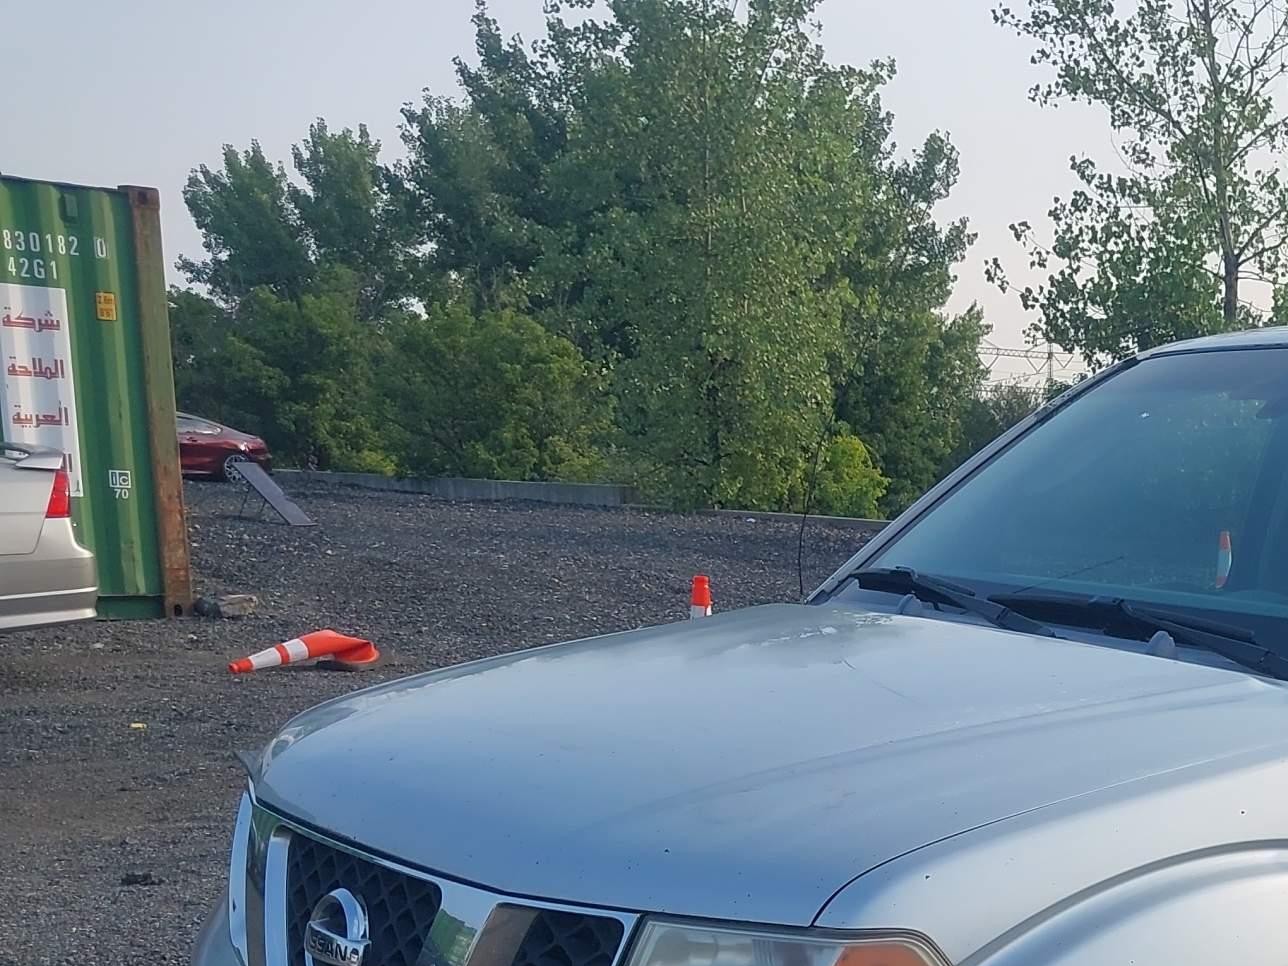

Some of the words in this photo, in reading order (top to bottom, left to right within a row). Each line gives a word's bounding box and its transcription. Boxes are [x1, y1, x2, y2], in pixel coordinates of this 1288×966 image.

[3, 229, 79, 255] 830182
[8, 257, 57, 280] 42G1
[2, 305, 60, 332] شركة
[8, 356, 64, 379] الملاحة
[12, 402, 69, 428] العربية
[114, 488, 129, 499] 70
